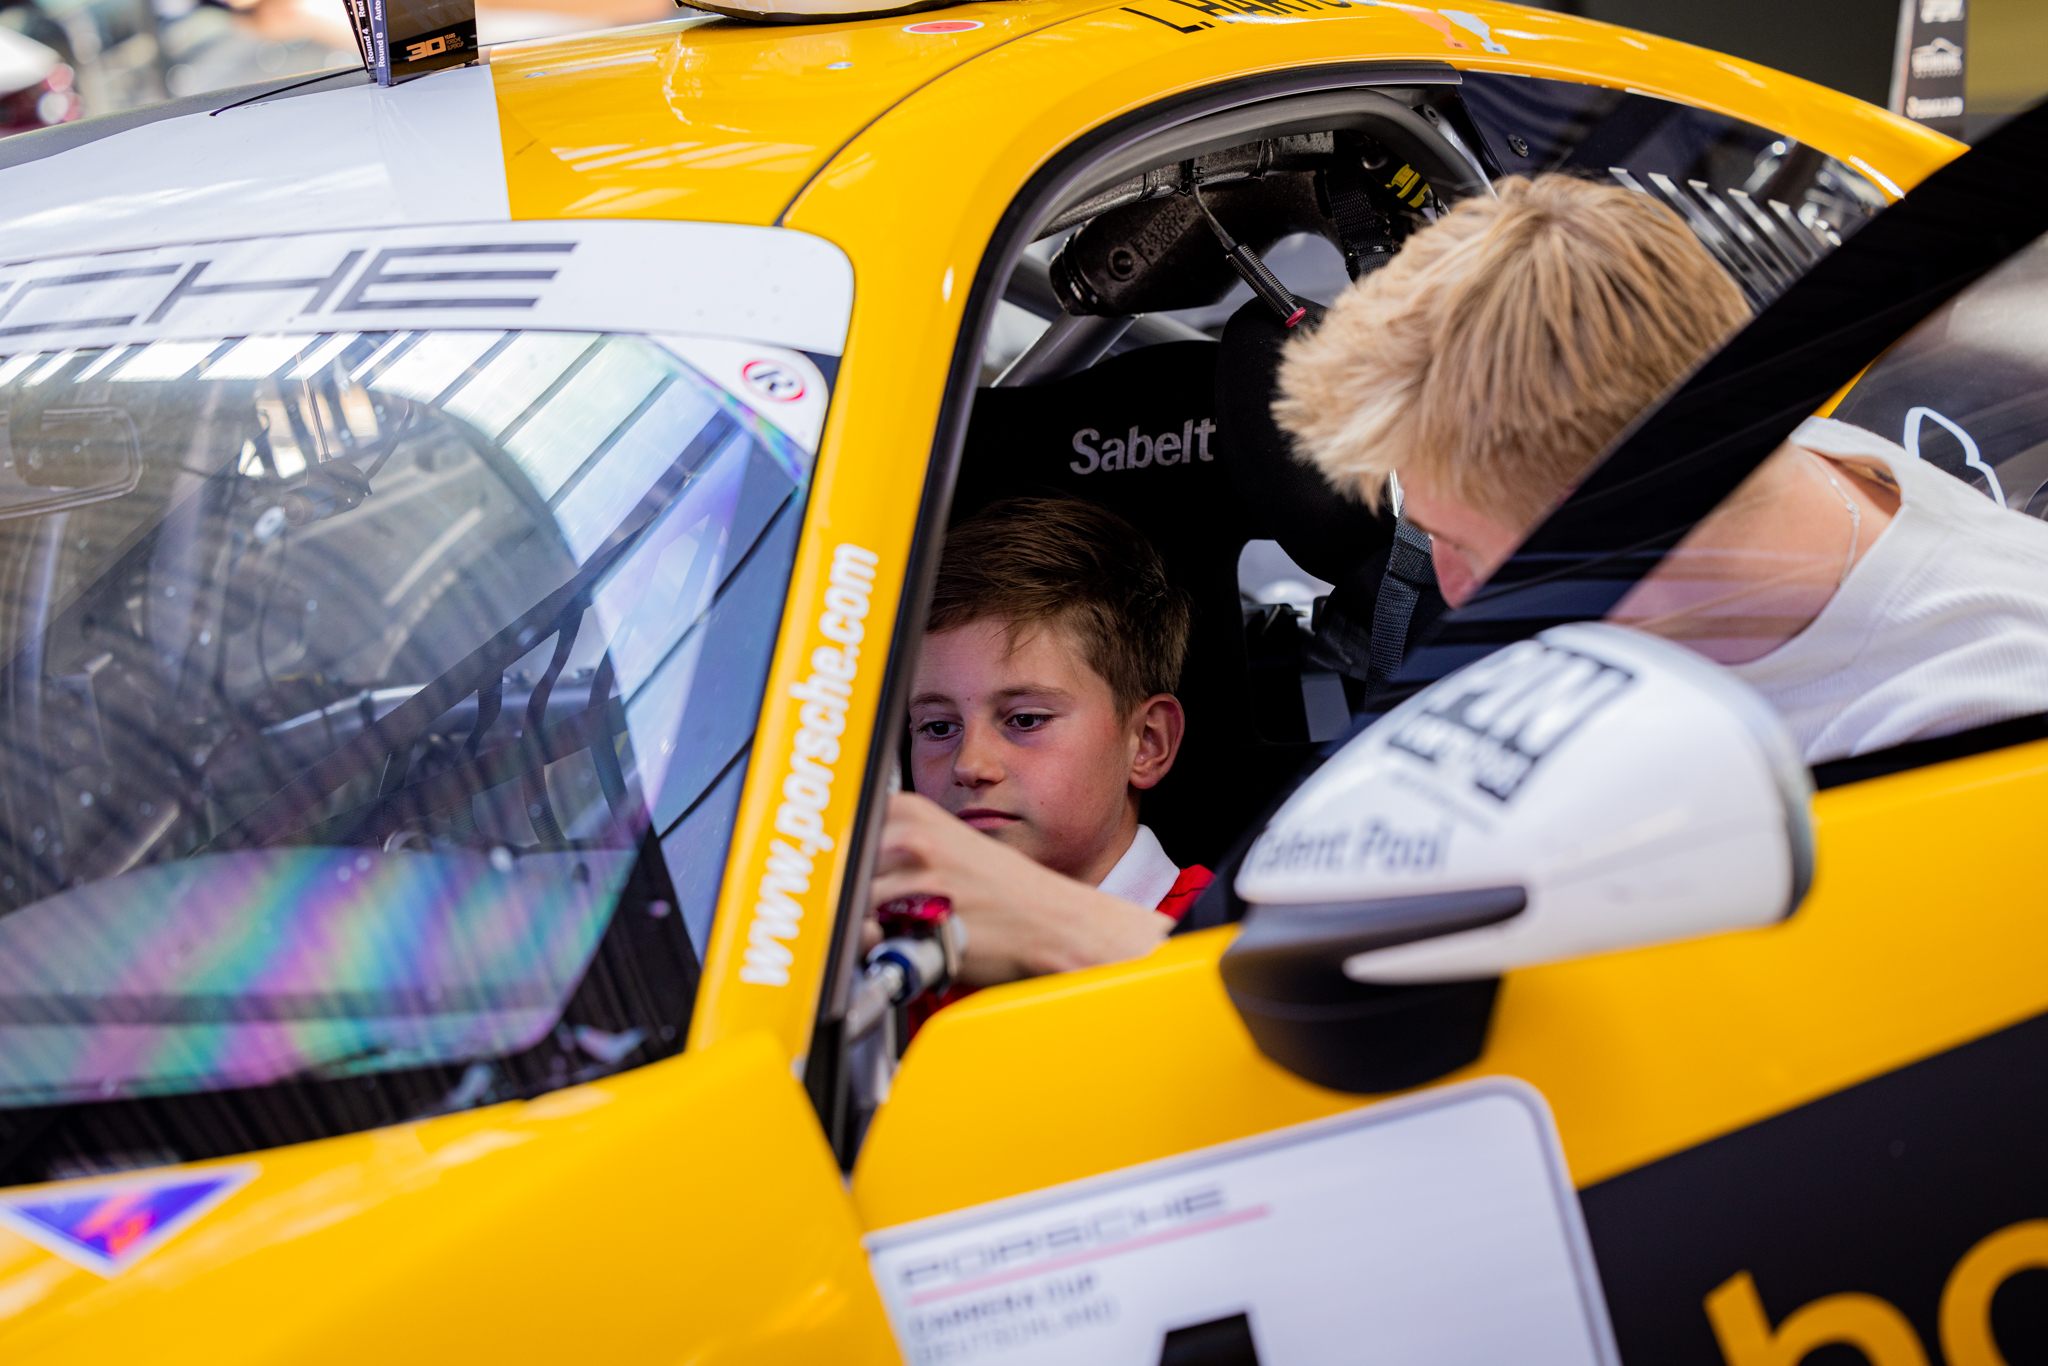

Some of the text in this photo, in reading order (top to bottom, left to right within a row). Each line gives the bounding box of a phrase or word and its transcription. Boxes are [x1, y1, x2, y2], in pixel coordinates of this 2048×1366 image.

[357, 1, 366, 17] Red
[364, 36, 375, 62] Round
[377, 40, 386, 67] Round
[406, 36, 446, 62] 30
[1069, 417, 1217, 476] Sabelt
[739, 542, 879, 988] www.porsche.com
[900, 1187, 1223, 1286] PORSCHE
